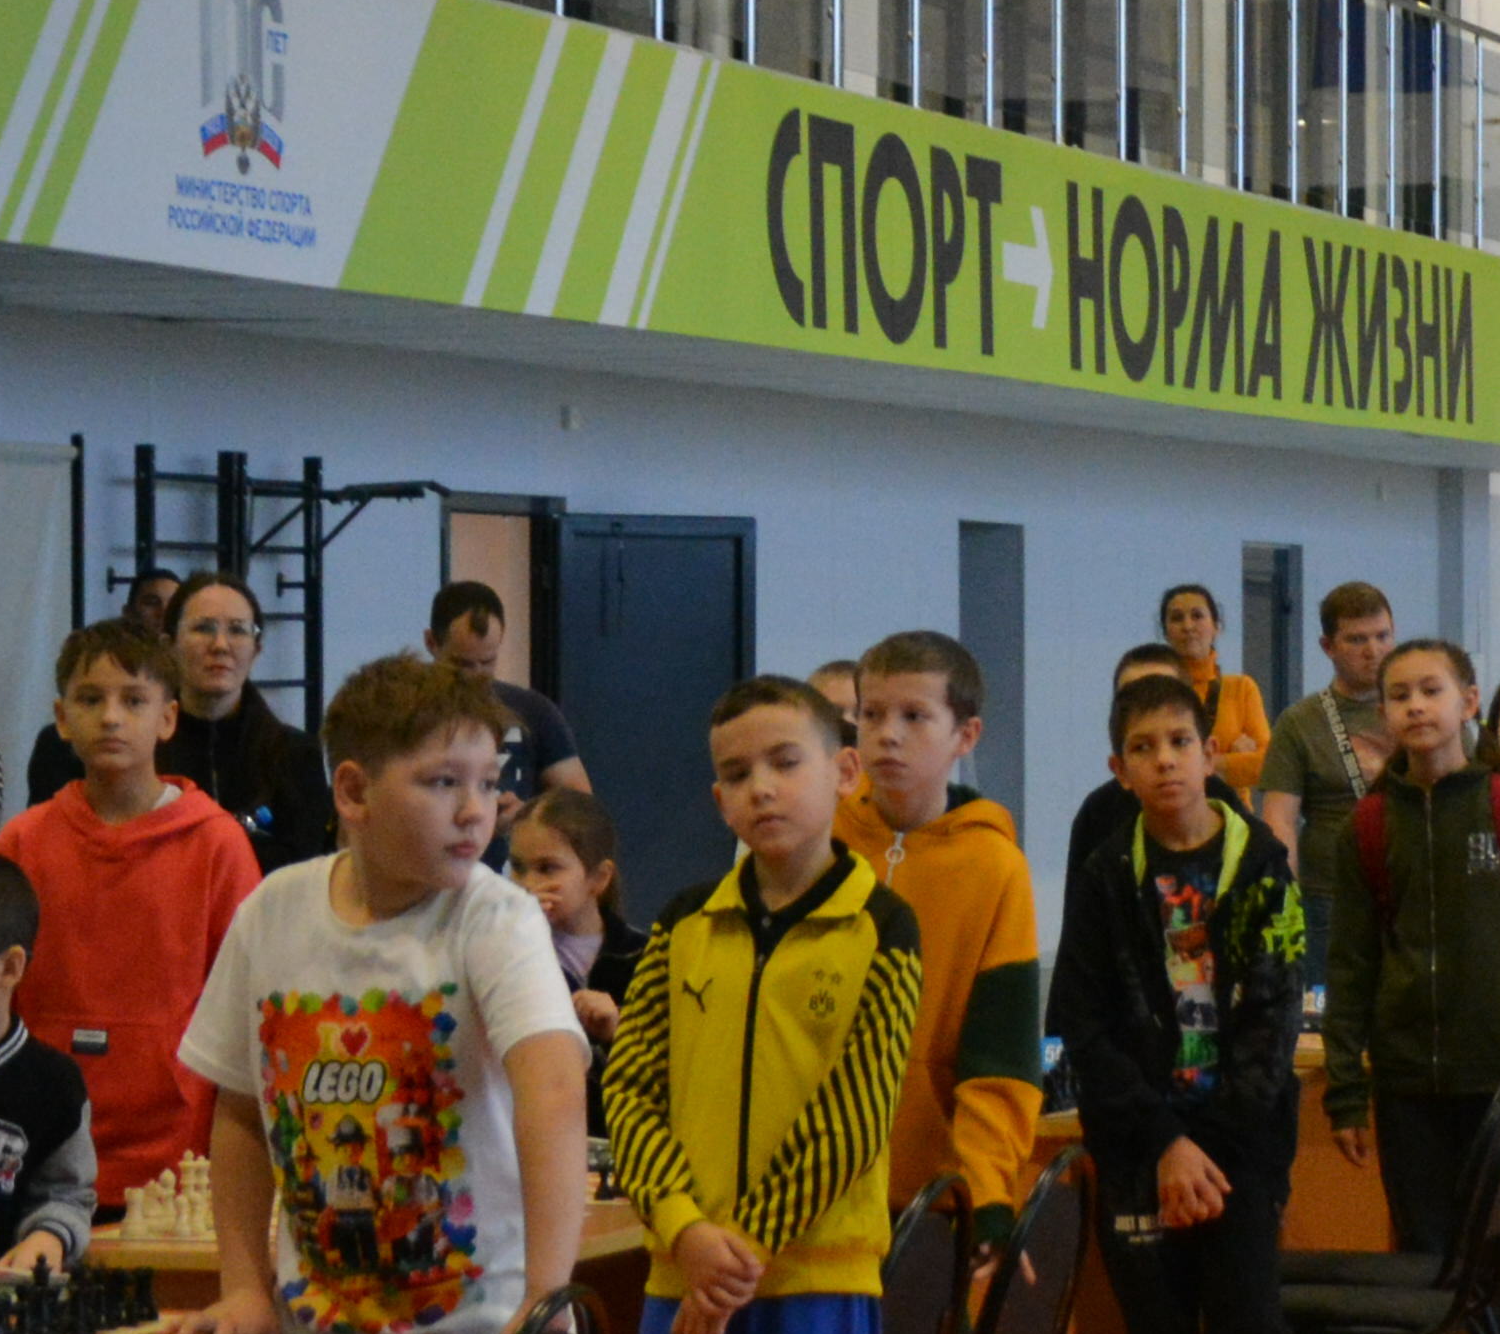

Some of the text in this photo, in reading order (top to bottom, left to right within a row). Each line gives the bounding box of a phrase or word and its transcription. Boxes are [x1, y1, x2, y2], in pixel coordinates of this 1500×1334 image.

[175, 174, 313, 216] МИНИСТЕРСТВО СПОРТА
[168, 204, 317, 248] РОССИЙСКОЙ ФЕДЕРАЦИИ
[767, 107, 1474, 424] СПОРТ НОРМА ЖИЗНИ
[302, 1058, 386, 1104] LEGO
